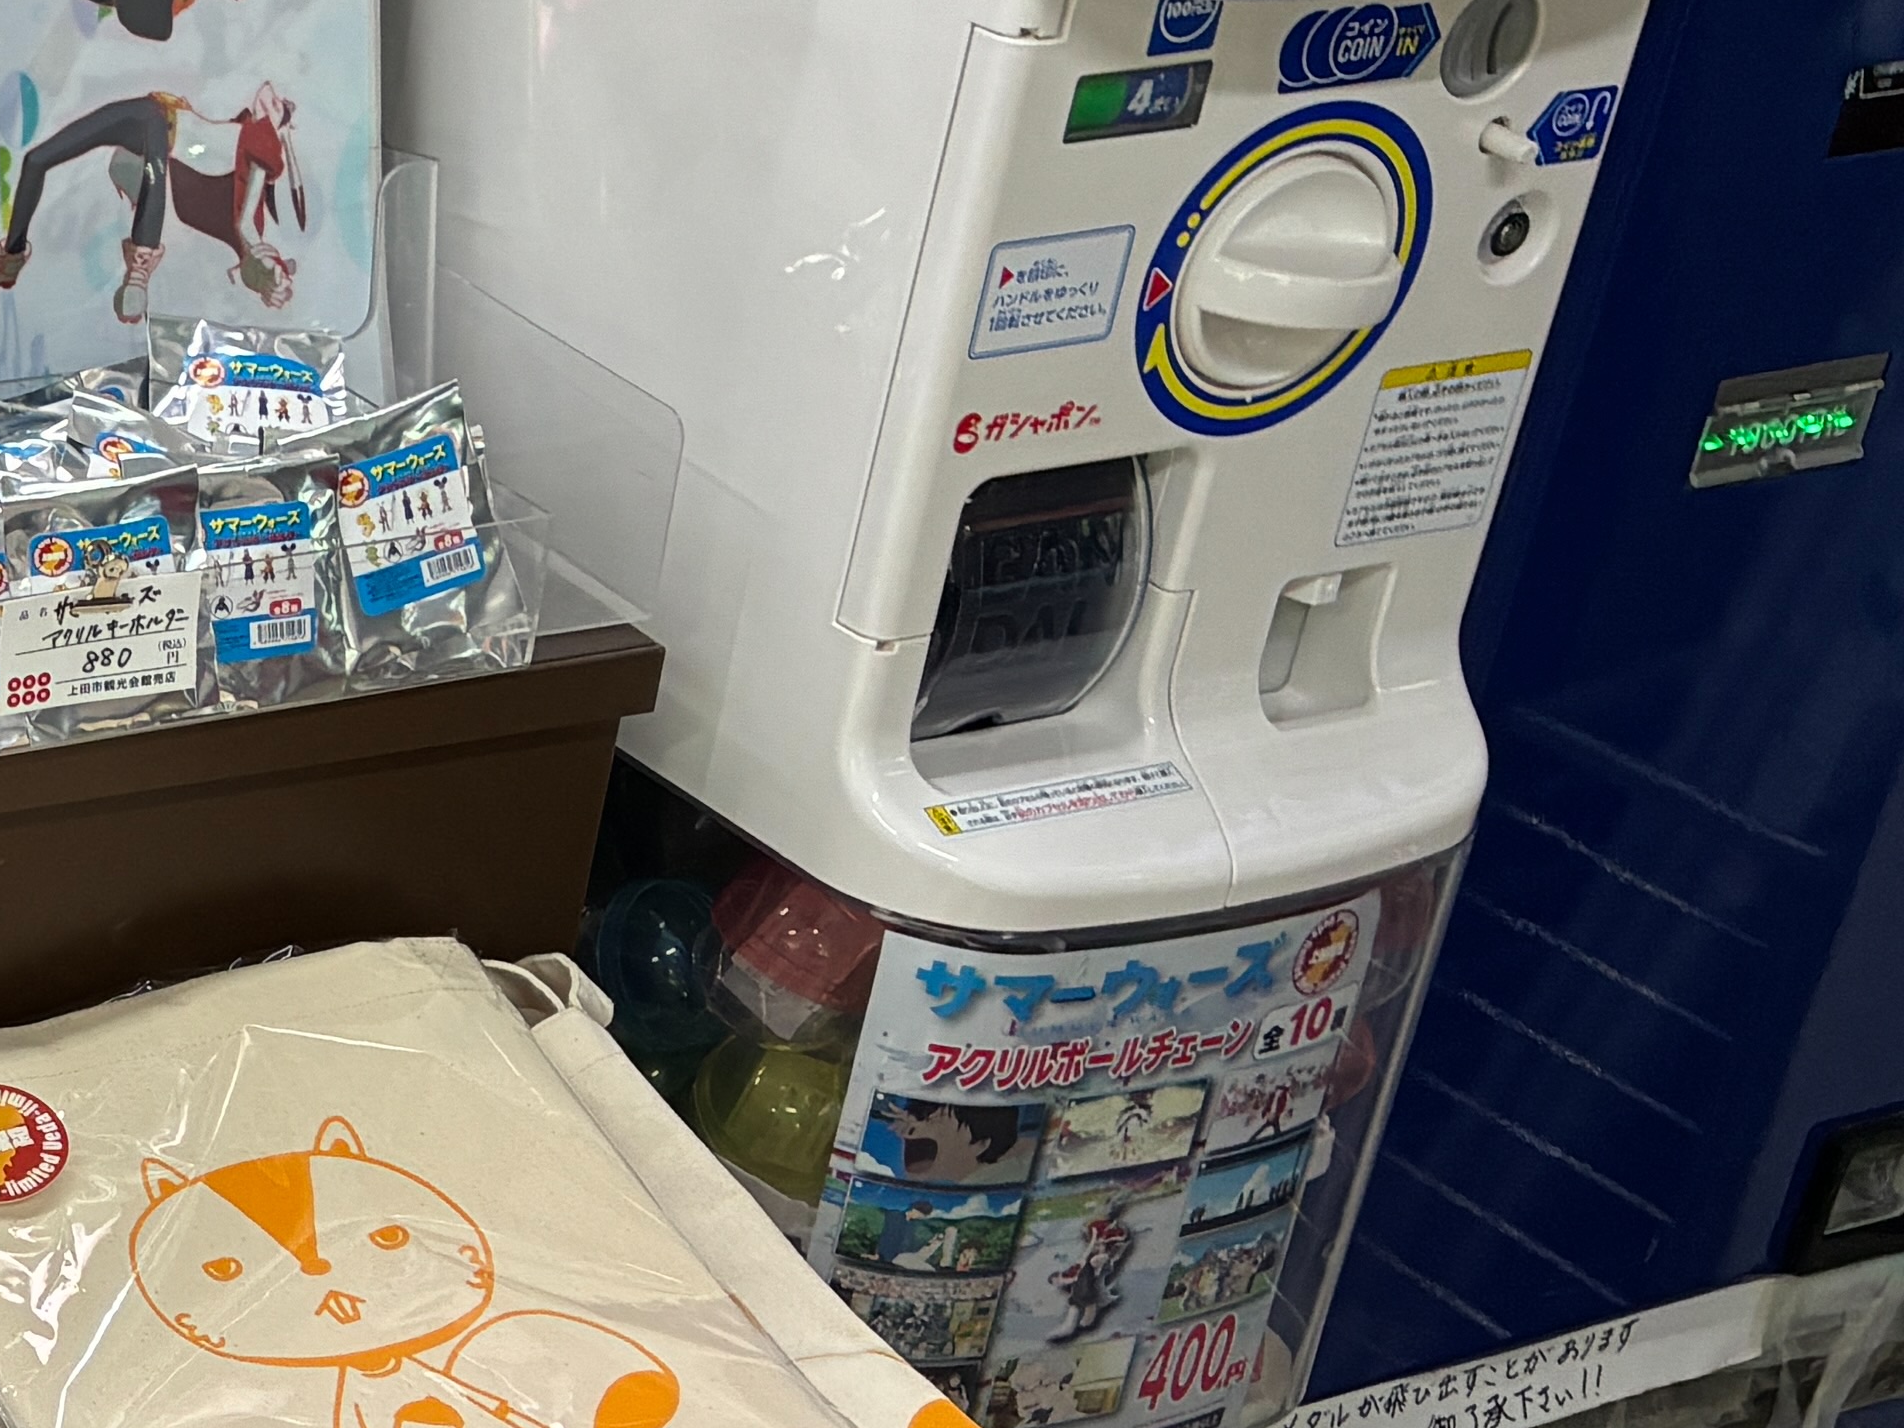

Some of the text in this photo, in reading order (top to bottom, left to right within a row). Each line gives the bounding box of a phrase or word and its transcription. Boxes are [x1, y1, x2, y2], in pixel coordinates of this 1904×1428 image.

[1346, 19, 1388, 35] コイン
[1338, 35, 1384, 62] COIN
[1397, 35, 1419, 56] IN
[230, 360, 314, 383] サマーウォーズ
[985, 401, 1097, 441] ガシャポン
[370, 442, 447, 482] サマーウォーズ
[209, 509, 300, 535] サマーウォーズ
[83, 647, 132, 673] 880
[167, 651, 179, 664] 円
[68, 672, 175, 697] 上田市観光会館売店
[916, 933, 1287, 1021] サマーウォーズ
[923, 1020, 1253, 1089] アクリルボールチェーン
